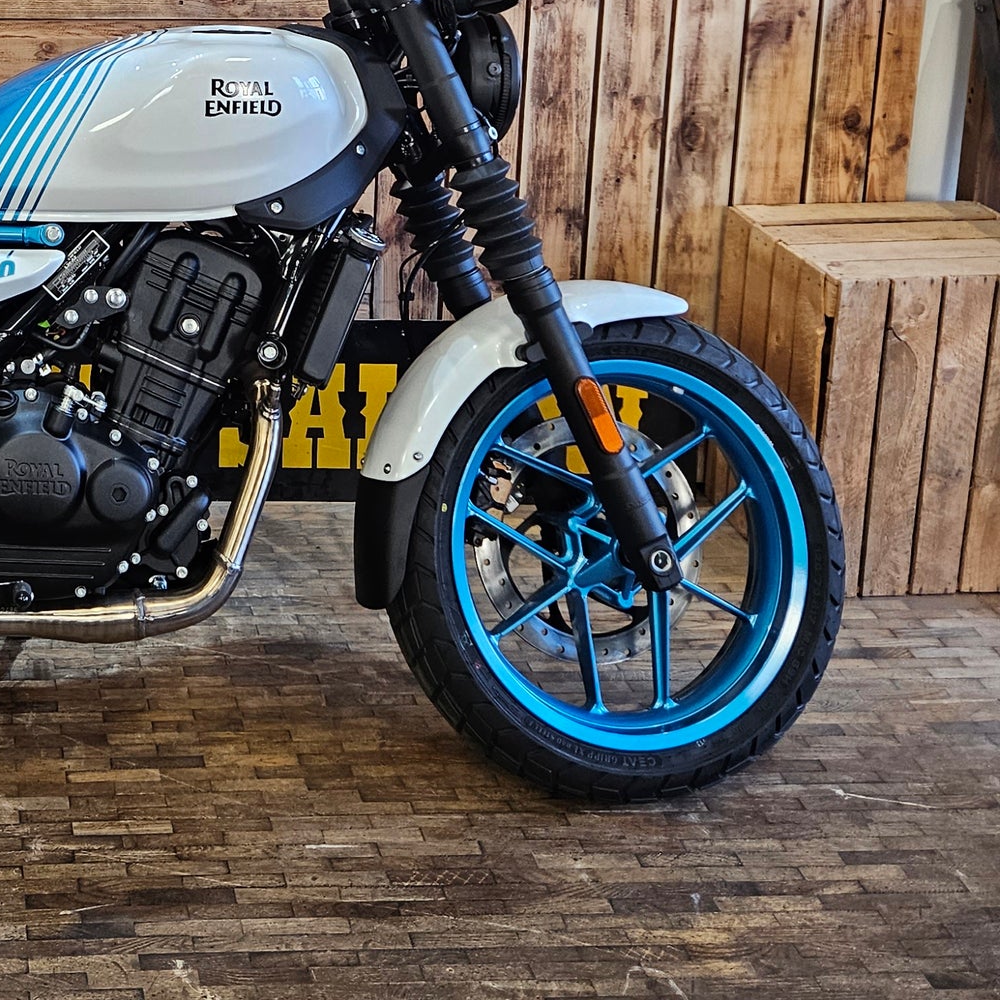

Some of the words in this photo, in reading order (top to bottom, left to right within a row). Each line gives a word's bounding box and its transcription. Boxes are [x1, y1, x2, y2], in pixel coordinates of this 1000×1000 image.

[211, 78, 274, 98] ROYAL
[205, 100, 282, 117] ENFIELD
[4, 458, 65, 478] ROYAL
[587, 752, 618, 764] GRIPP
[622, 756, 657, 767] CEAT
